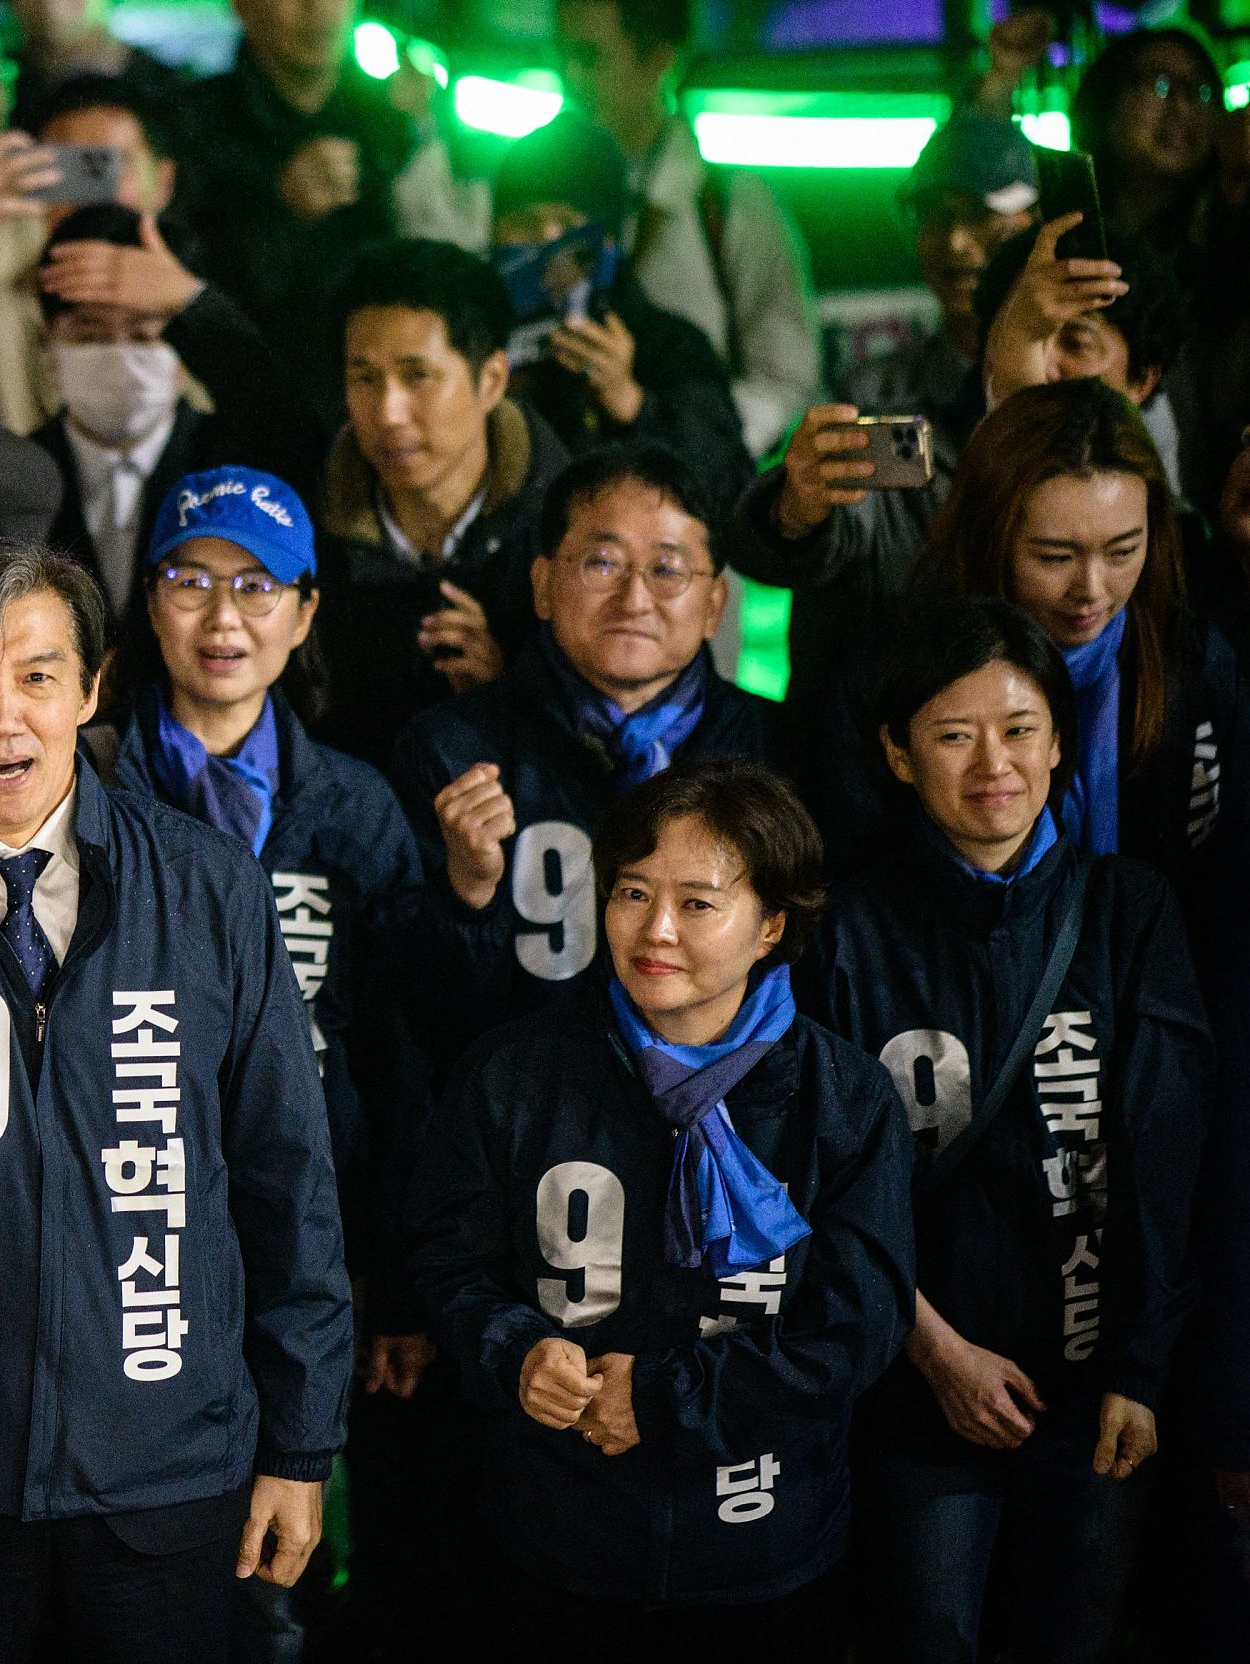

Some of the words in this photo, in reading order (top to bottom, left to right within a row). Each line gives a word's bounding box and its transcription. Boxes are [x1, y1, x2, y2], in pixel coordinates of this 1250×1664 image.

[512, 820, 598, 981] 9
[101, 989, 190, 1382] 조국혁신당
[536, 1160, 626, 1328] 9
